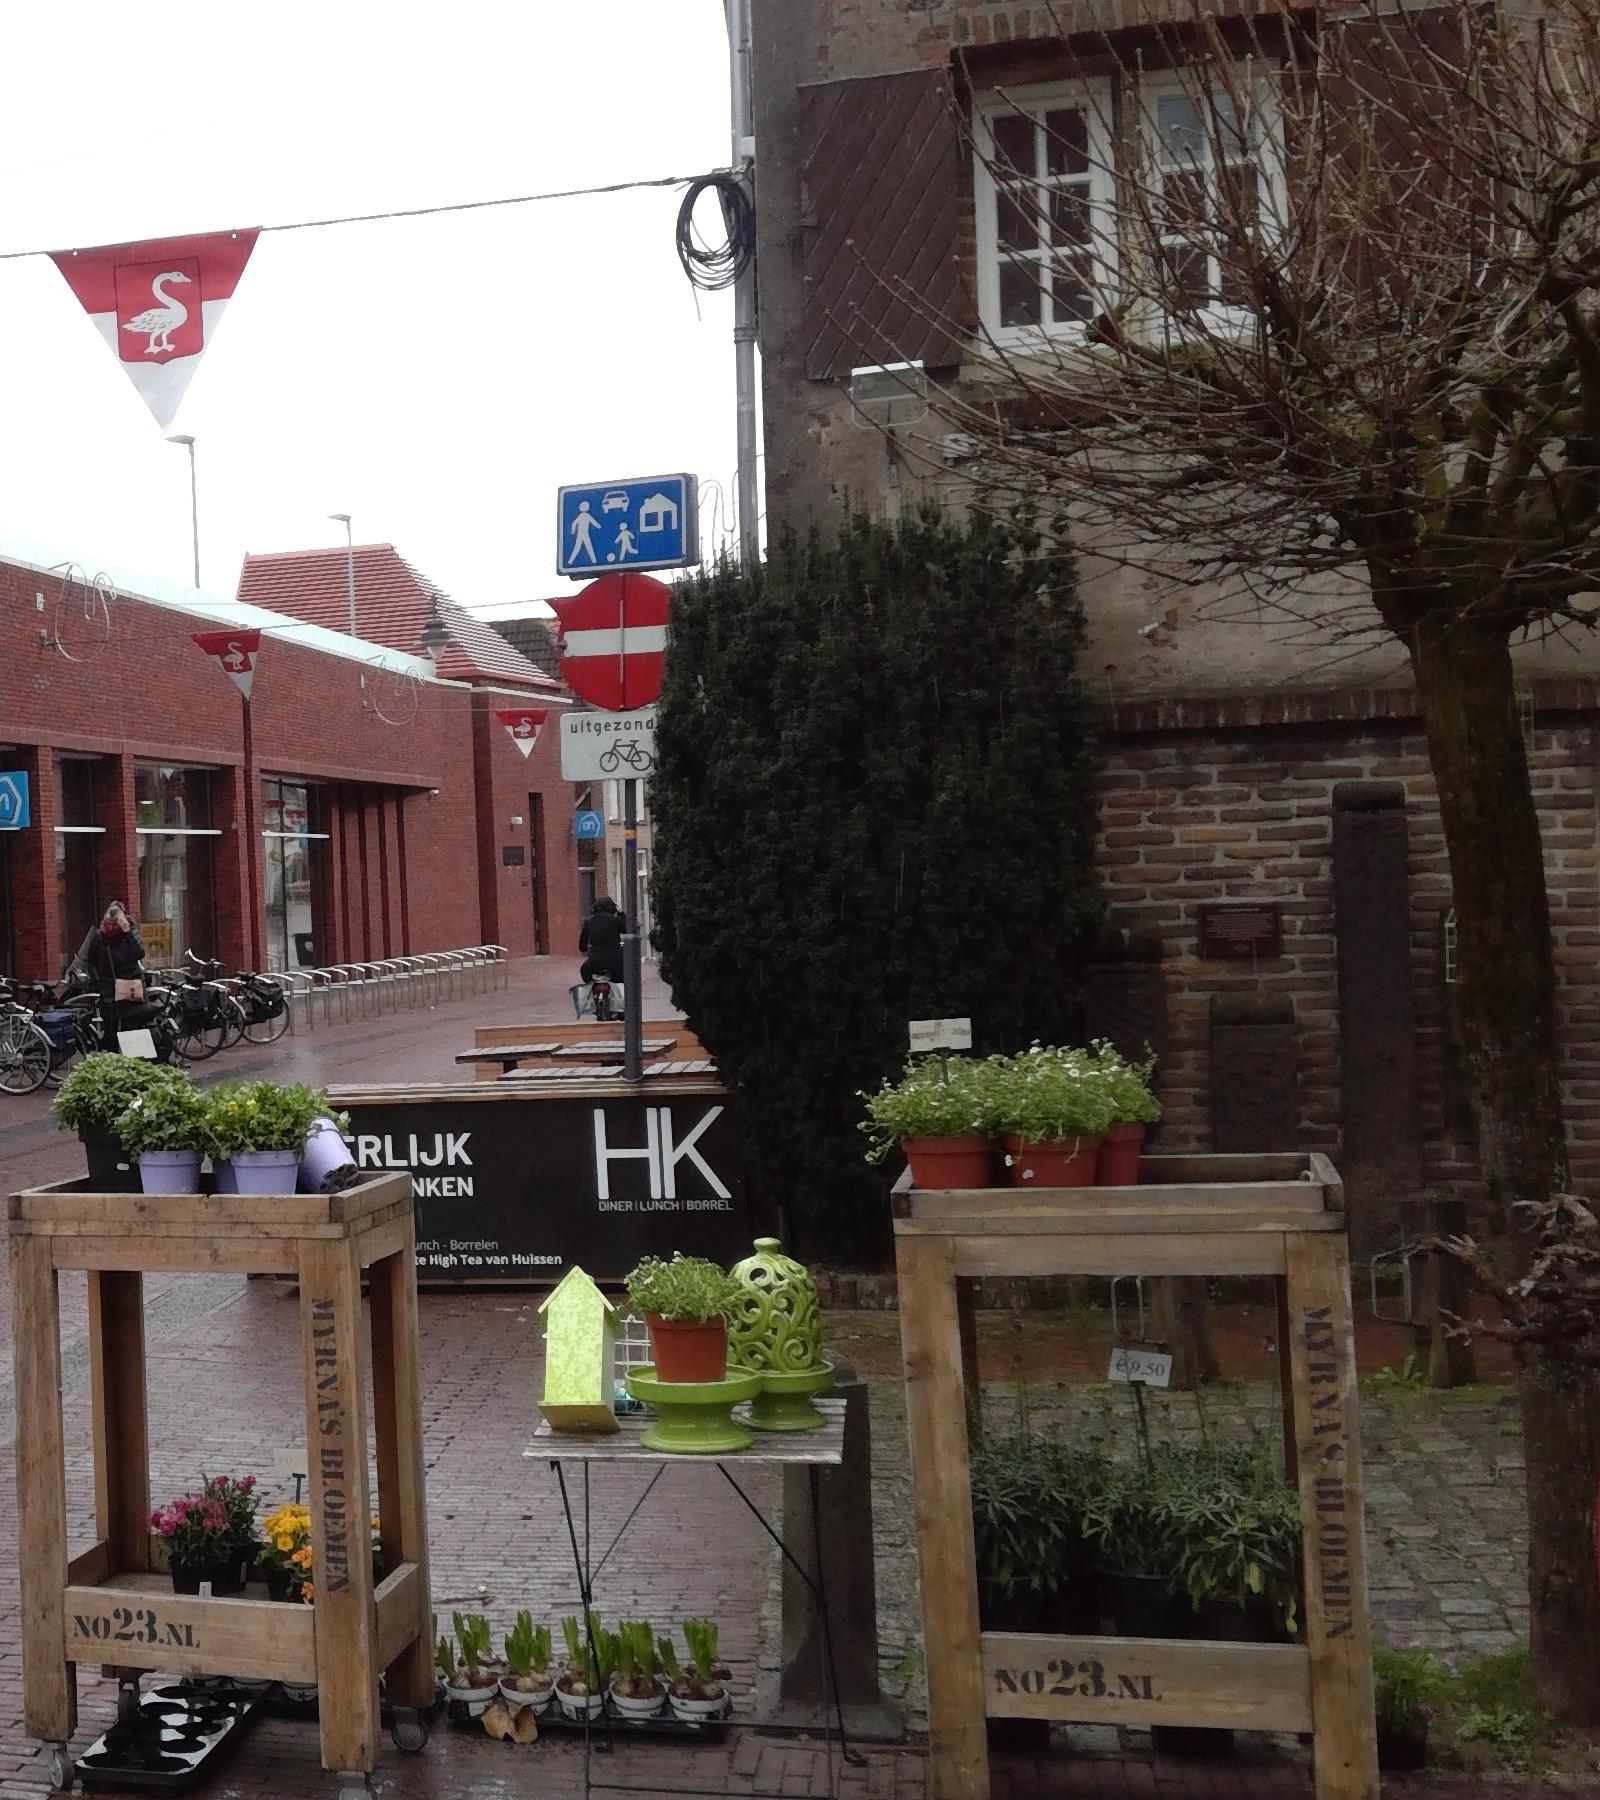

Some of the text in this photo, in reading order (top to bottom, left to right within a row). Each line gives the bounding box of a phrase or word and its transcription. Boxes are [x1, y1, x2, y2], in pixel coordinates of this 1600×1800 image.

[593, 1105, 732, 1200] HK
[599, 1200, 733, 1212] DINER LUNCH BORREL
[429, 1253, 458, 1268] High
[460, 1254, 483, 1265] Tea
[485, 1255, 509, 1266] van
[512, 1252, 563, 1266] Huissen
[450, 1239, 499, 1251] Borrelen
[320, 1447, 349, 1594] BLOEMEN
[74, 1607, 201, 1649] NO23.NL
[994, 1659, 1163, 1701] NO23.NL
